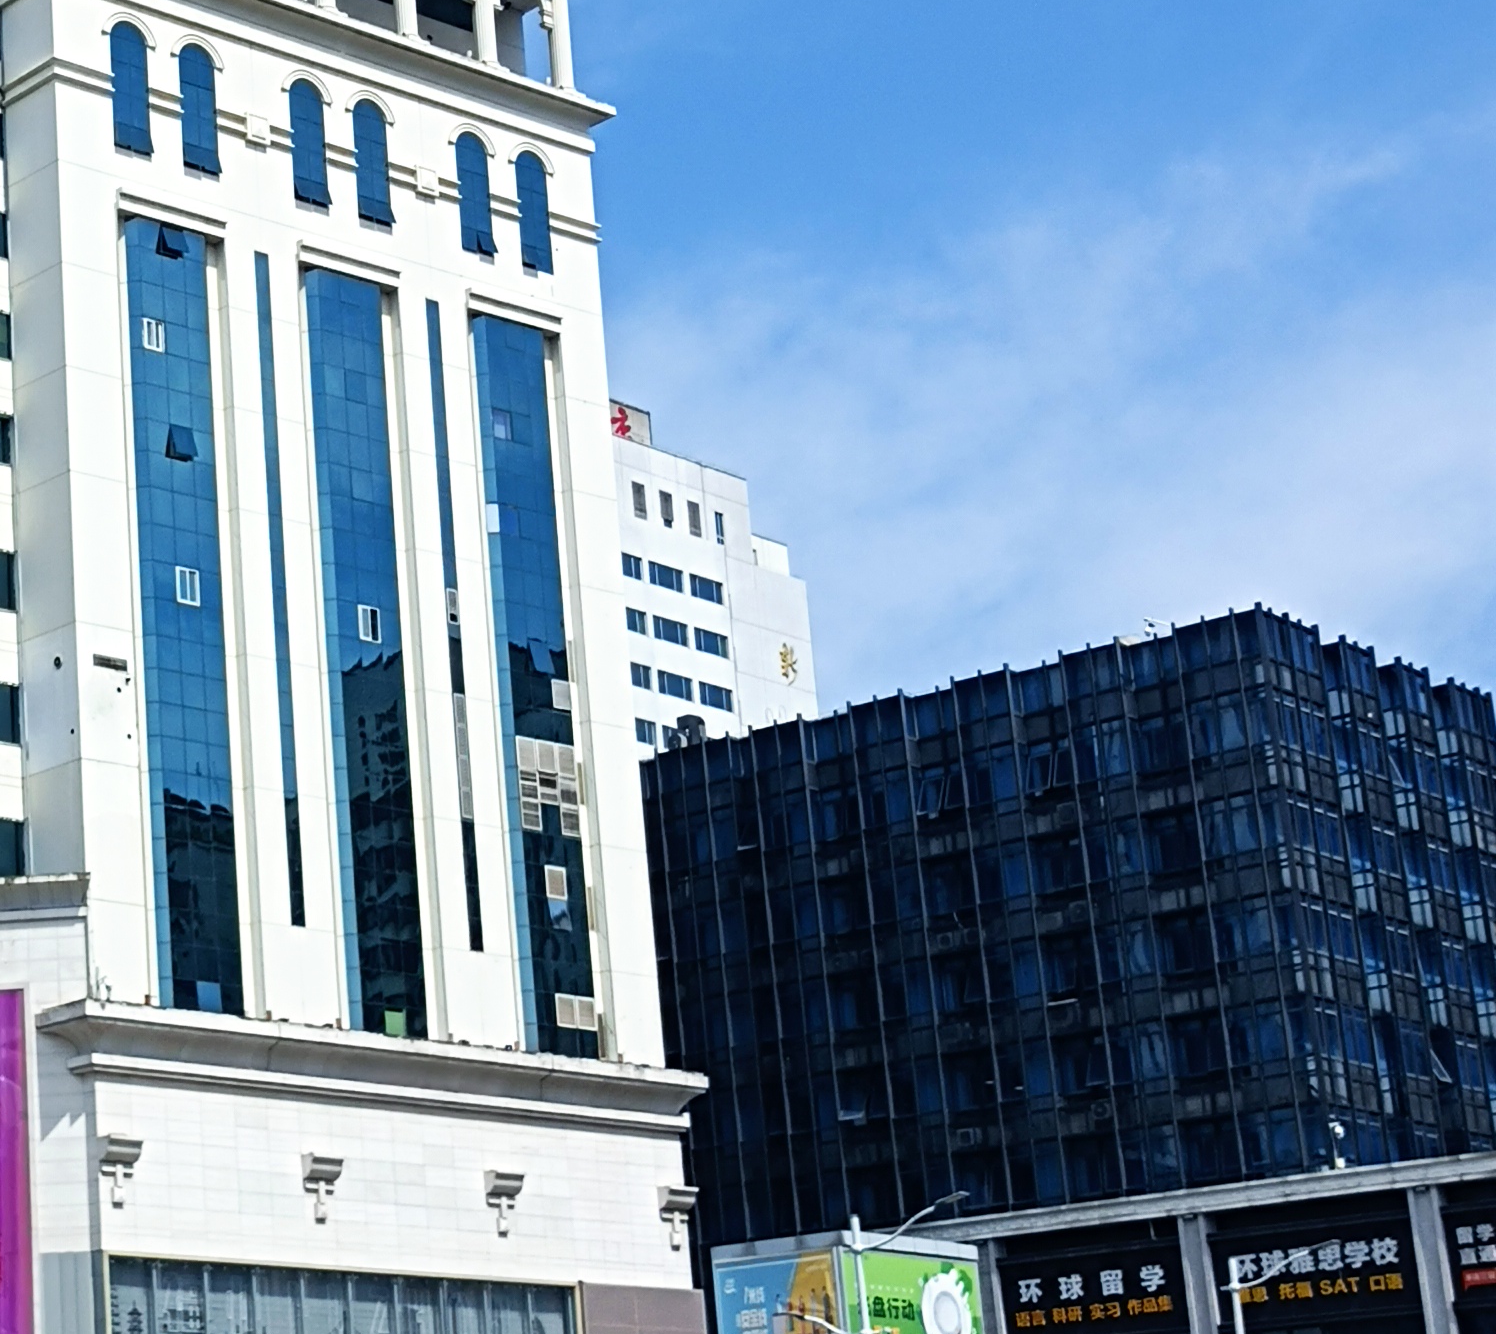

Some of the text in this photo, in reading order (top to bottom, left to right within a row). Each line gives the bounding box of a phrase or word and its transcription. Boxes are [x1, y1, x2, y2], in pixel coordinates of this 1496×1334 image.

[1235, 1237, 1399, 1279] 环球雅思学校
[1018, 1265, 1166, 1303] 环球留学
[1320, 1277, 1360, 1295] SAT
